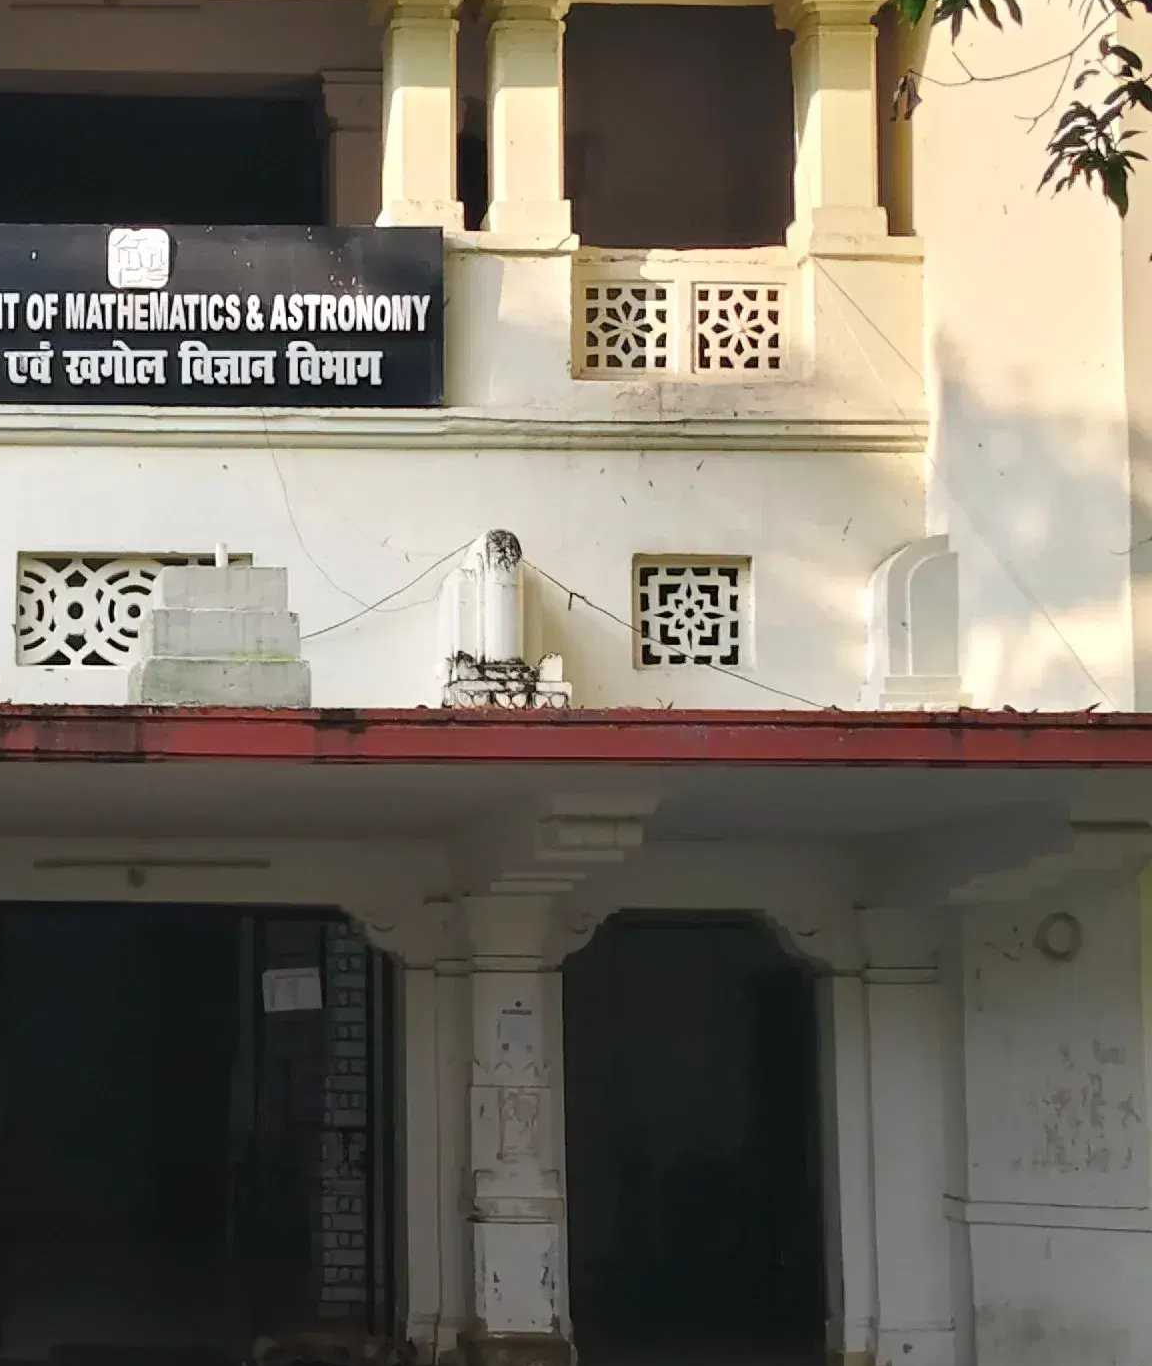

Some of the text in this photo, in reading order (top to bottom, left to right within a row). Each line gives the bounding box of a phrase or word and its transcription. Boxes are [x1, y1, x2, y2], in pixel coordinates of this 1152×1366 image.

[26, 292, 58, 331] OF
[65, 292, 240, 331] MATHEMATICS
[246, 294, 265, 331] &
[269, 294, 430, 332] ASTRONOMY
[4, 341, 54, 384] एवं
[62, 339, 168, 385] खगोल
[177, 340, 276, 385] विज्ञान
[285, 340, 383, 385] विभाग
